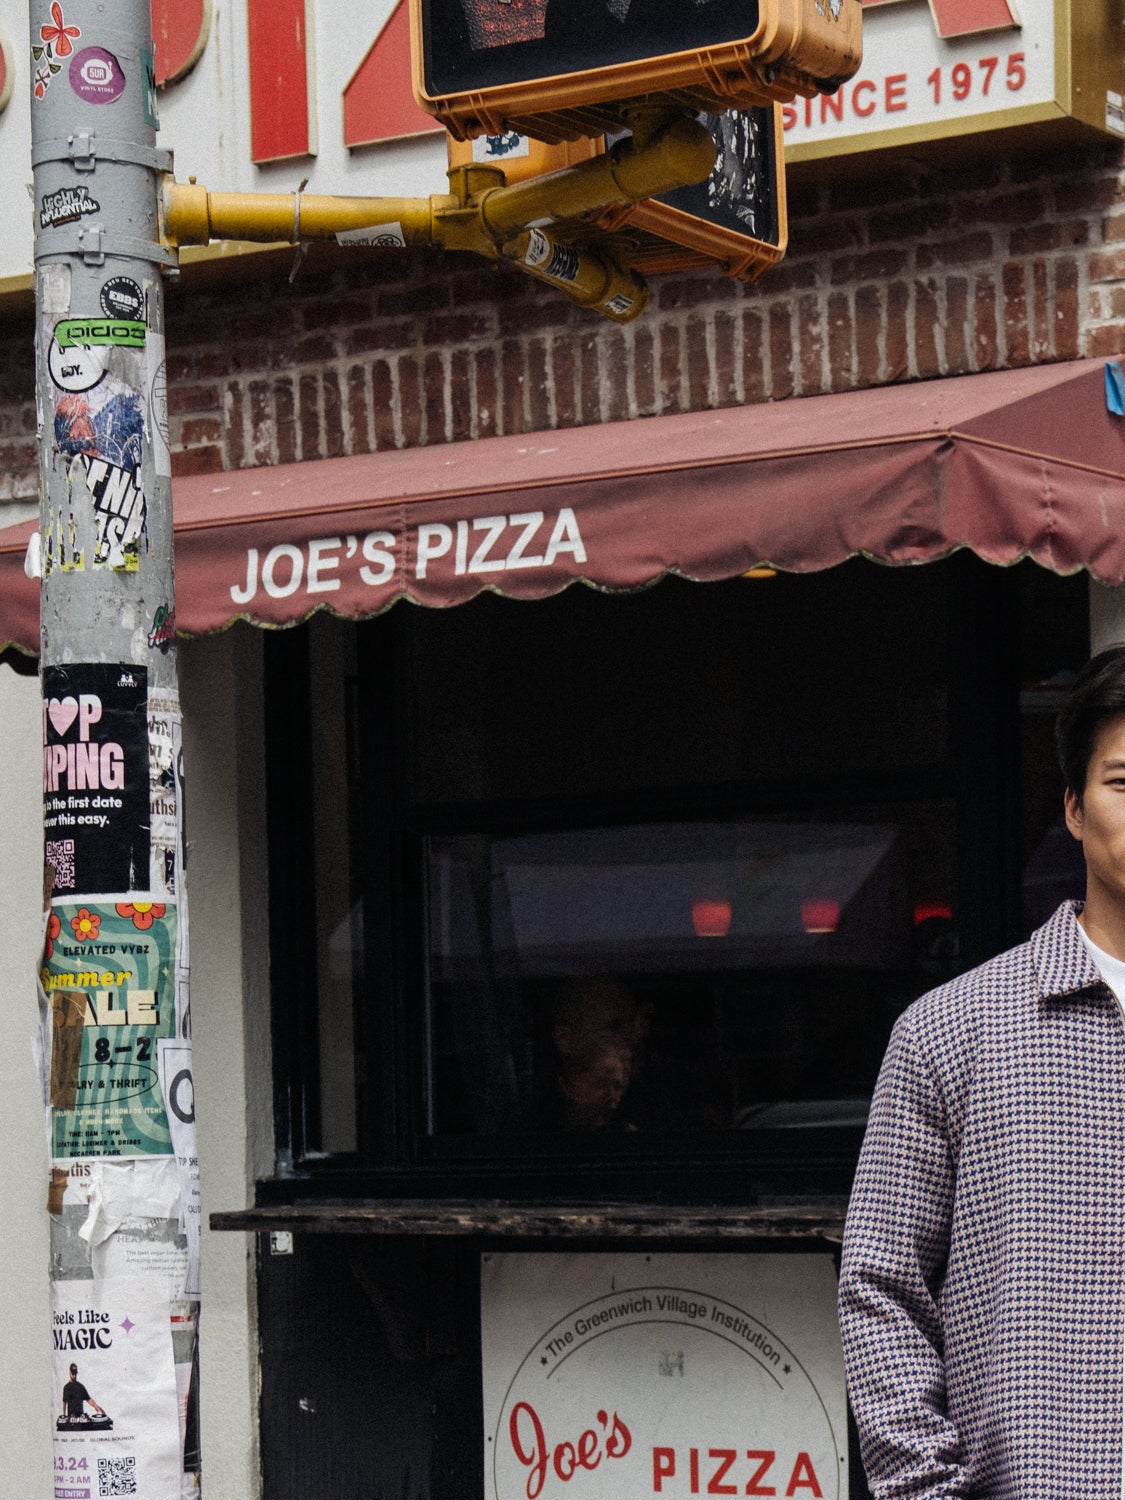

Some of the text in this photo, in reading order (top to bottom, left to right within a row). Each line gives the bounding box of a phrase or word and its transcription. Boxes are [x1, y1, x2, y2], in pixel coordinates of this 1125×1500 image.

[783, 52, 1026, 130] SINCE 1975
[230, 507, 588, 604] JOE'S PIZZA
[68, 796, 89, 808] first
[92, 796, 122, 808] date
[58, 814, 76, 825] this
[77, 815, 110, 828] easy.
[63, 945, 150, 956] ELEVATED VYBZ
[41, 967, 132, 991] Summer
[110, 1078, 147, 1089] THRIFT
[78, 1310, 110, 1324] Like
[53, 1328, 113, 1350] MAGIC
[546, 1295, 781, 1366] The Greenwich Village Institution
[509, 1401, 824, 1500] Joe's PIZZA
